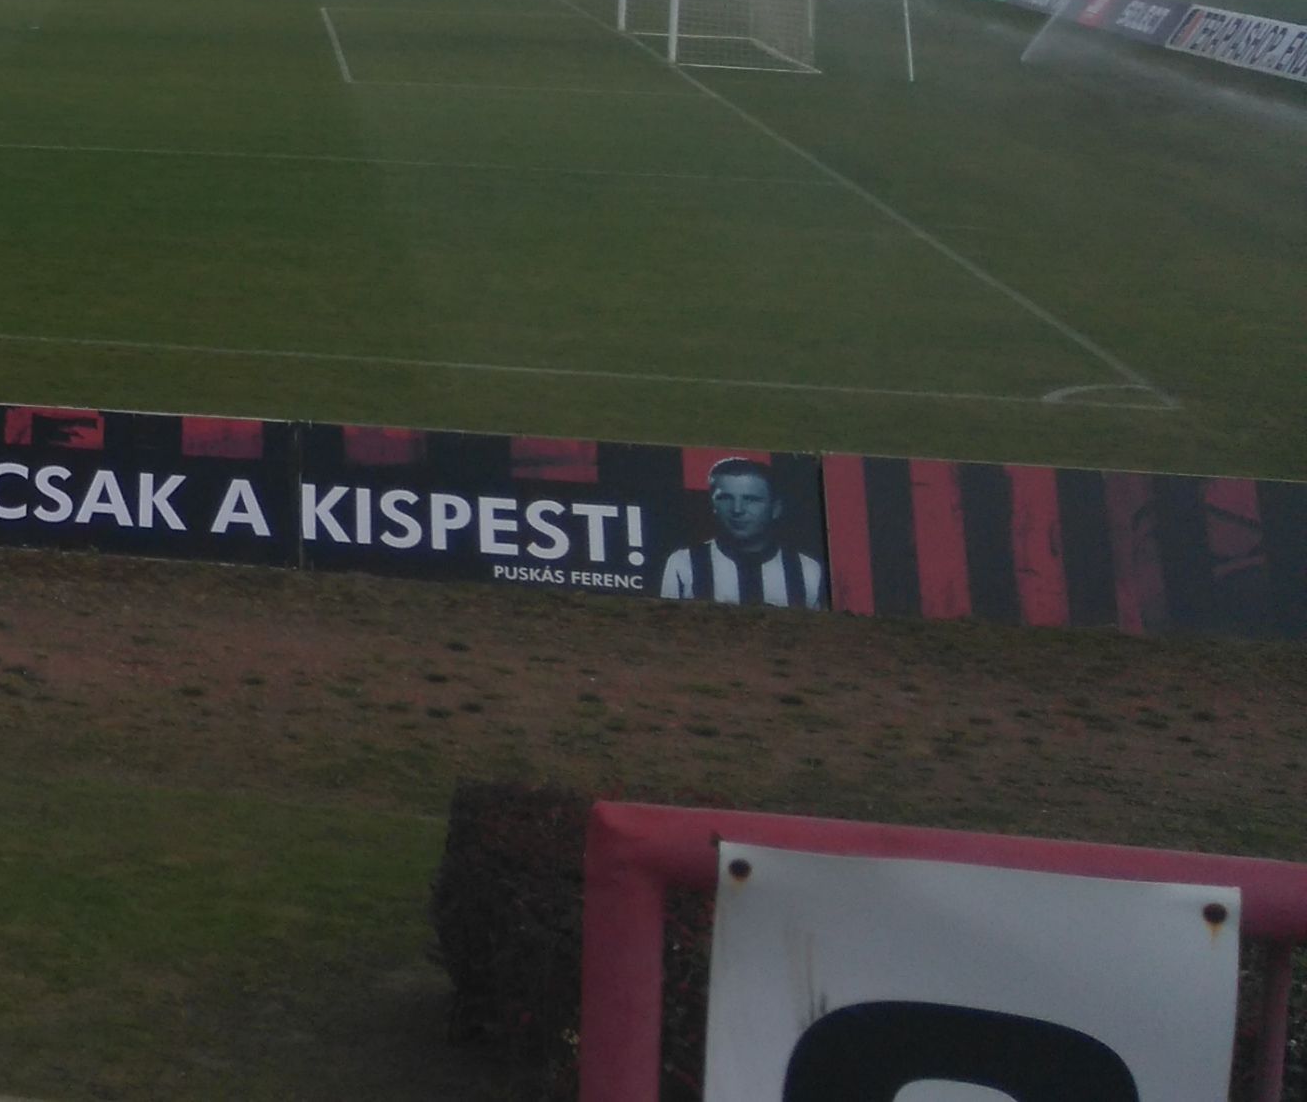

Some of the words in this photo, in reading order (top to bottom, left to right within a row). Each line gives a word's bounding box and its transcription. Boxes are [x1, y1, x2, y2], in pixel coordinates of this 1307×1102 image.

[211, 478, 272, 538] A
[301, 483, 645, 566] KISPEST!
[493, 565, 565, 584] PUSKÁS
[570, 570, 644, 589] FERENC
